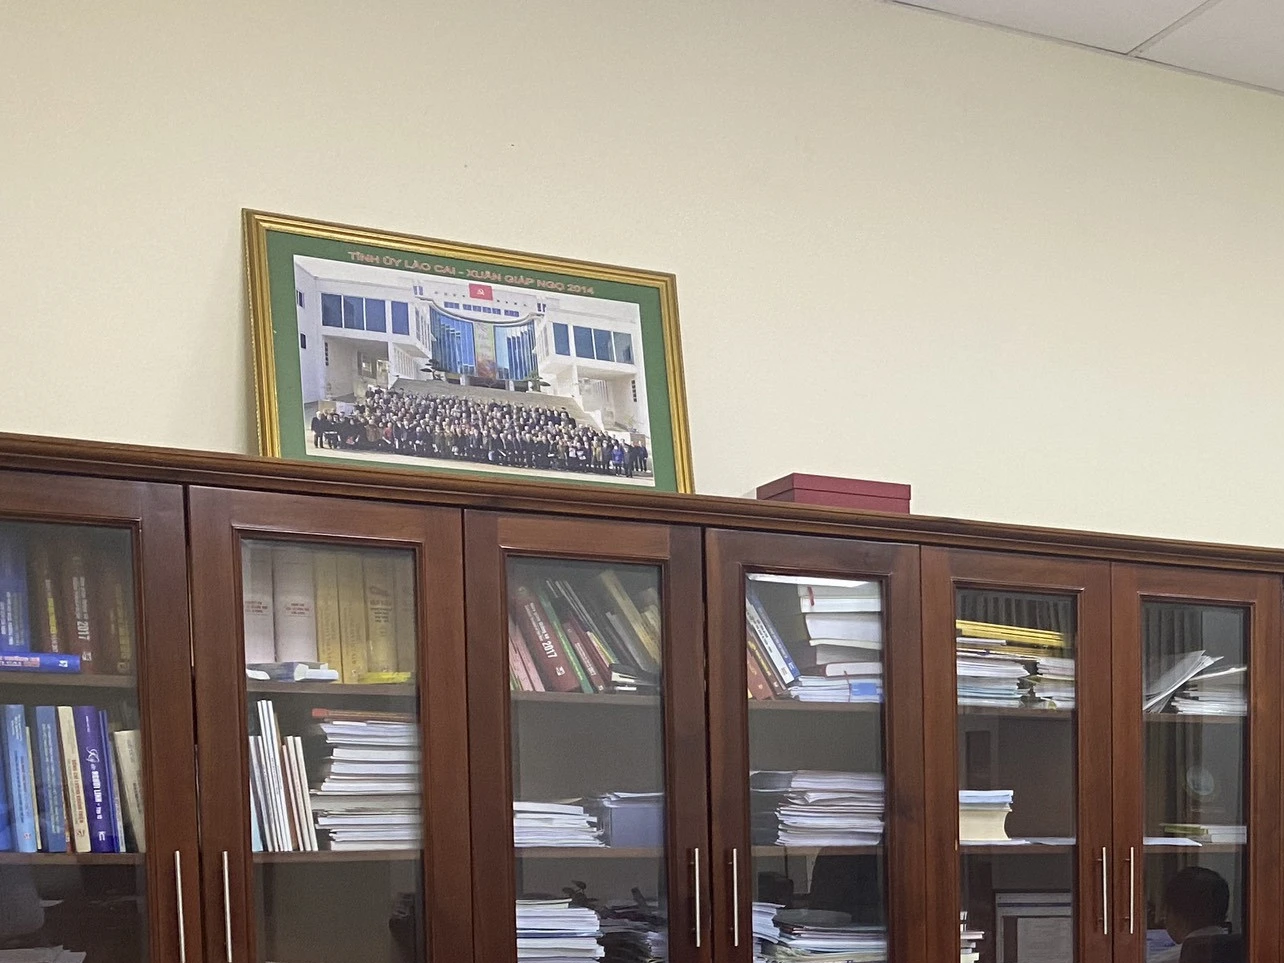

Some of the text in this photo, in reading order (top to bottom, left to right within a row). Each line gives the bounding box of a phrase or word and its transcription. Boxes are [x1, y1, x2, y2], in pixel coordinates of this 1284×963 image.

[404, 259, 431, 271] LÀO
[434, 264, 456, 275] CAI
[567, 283, 594, 295] 2014
[77, 621, 90, 640] 2017
[542, 640, 558, 658] 2017
